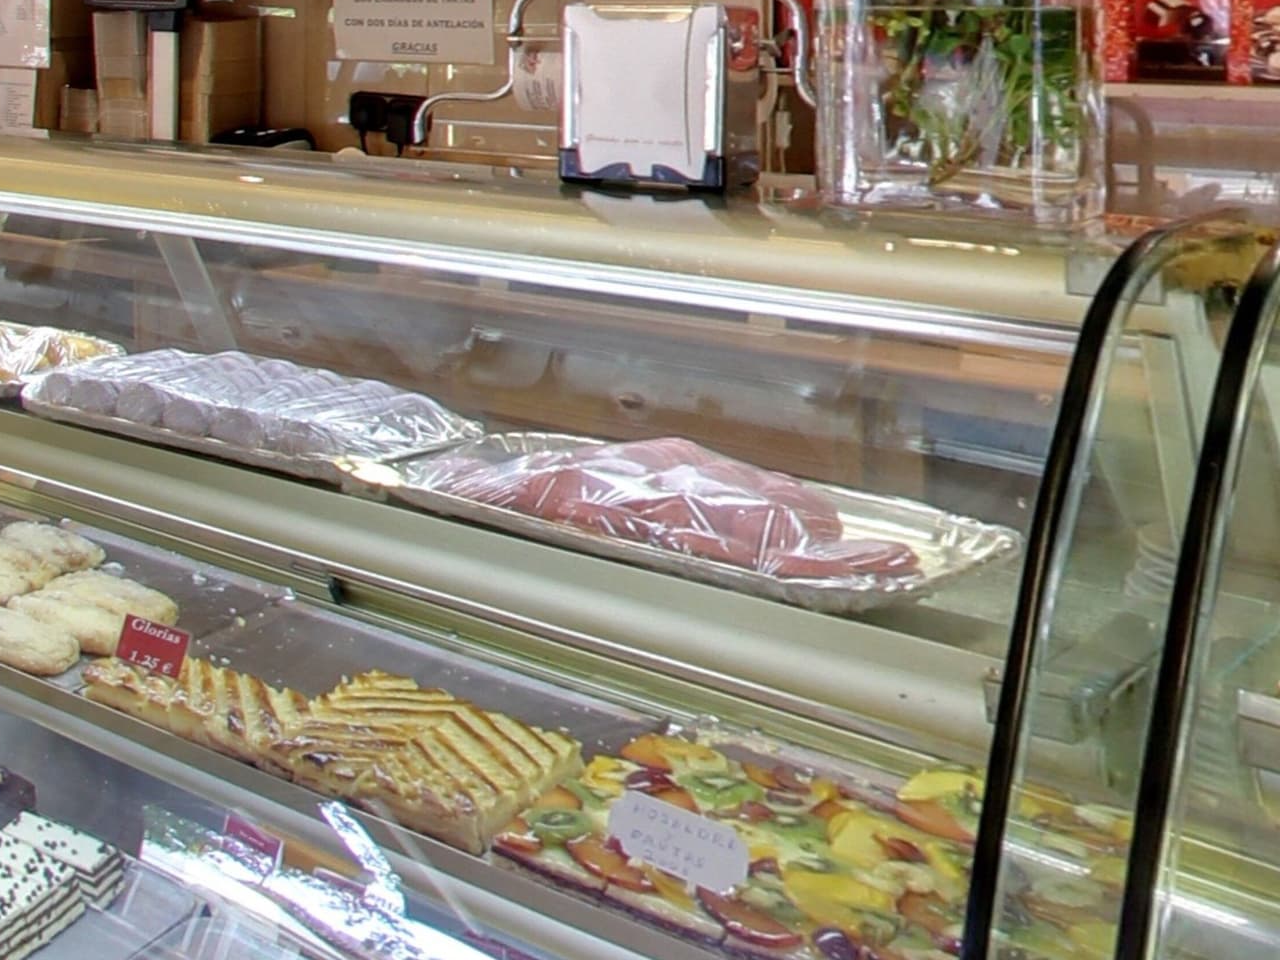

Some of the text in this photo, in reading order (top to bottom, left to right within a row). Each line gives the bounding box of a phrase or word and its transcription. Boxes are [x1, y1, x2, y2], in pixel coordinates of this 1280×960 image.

[344, 18, 364, 27] CON
[367, 18, 385, 27] DOS
[411, 19, 424, 28] DE
[391, 41, 438, 53] GRACIAS
[130, 618, 181, 645] Glorias
